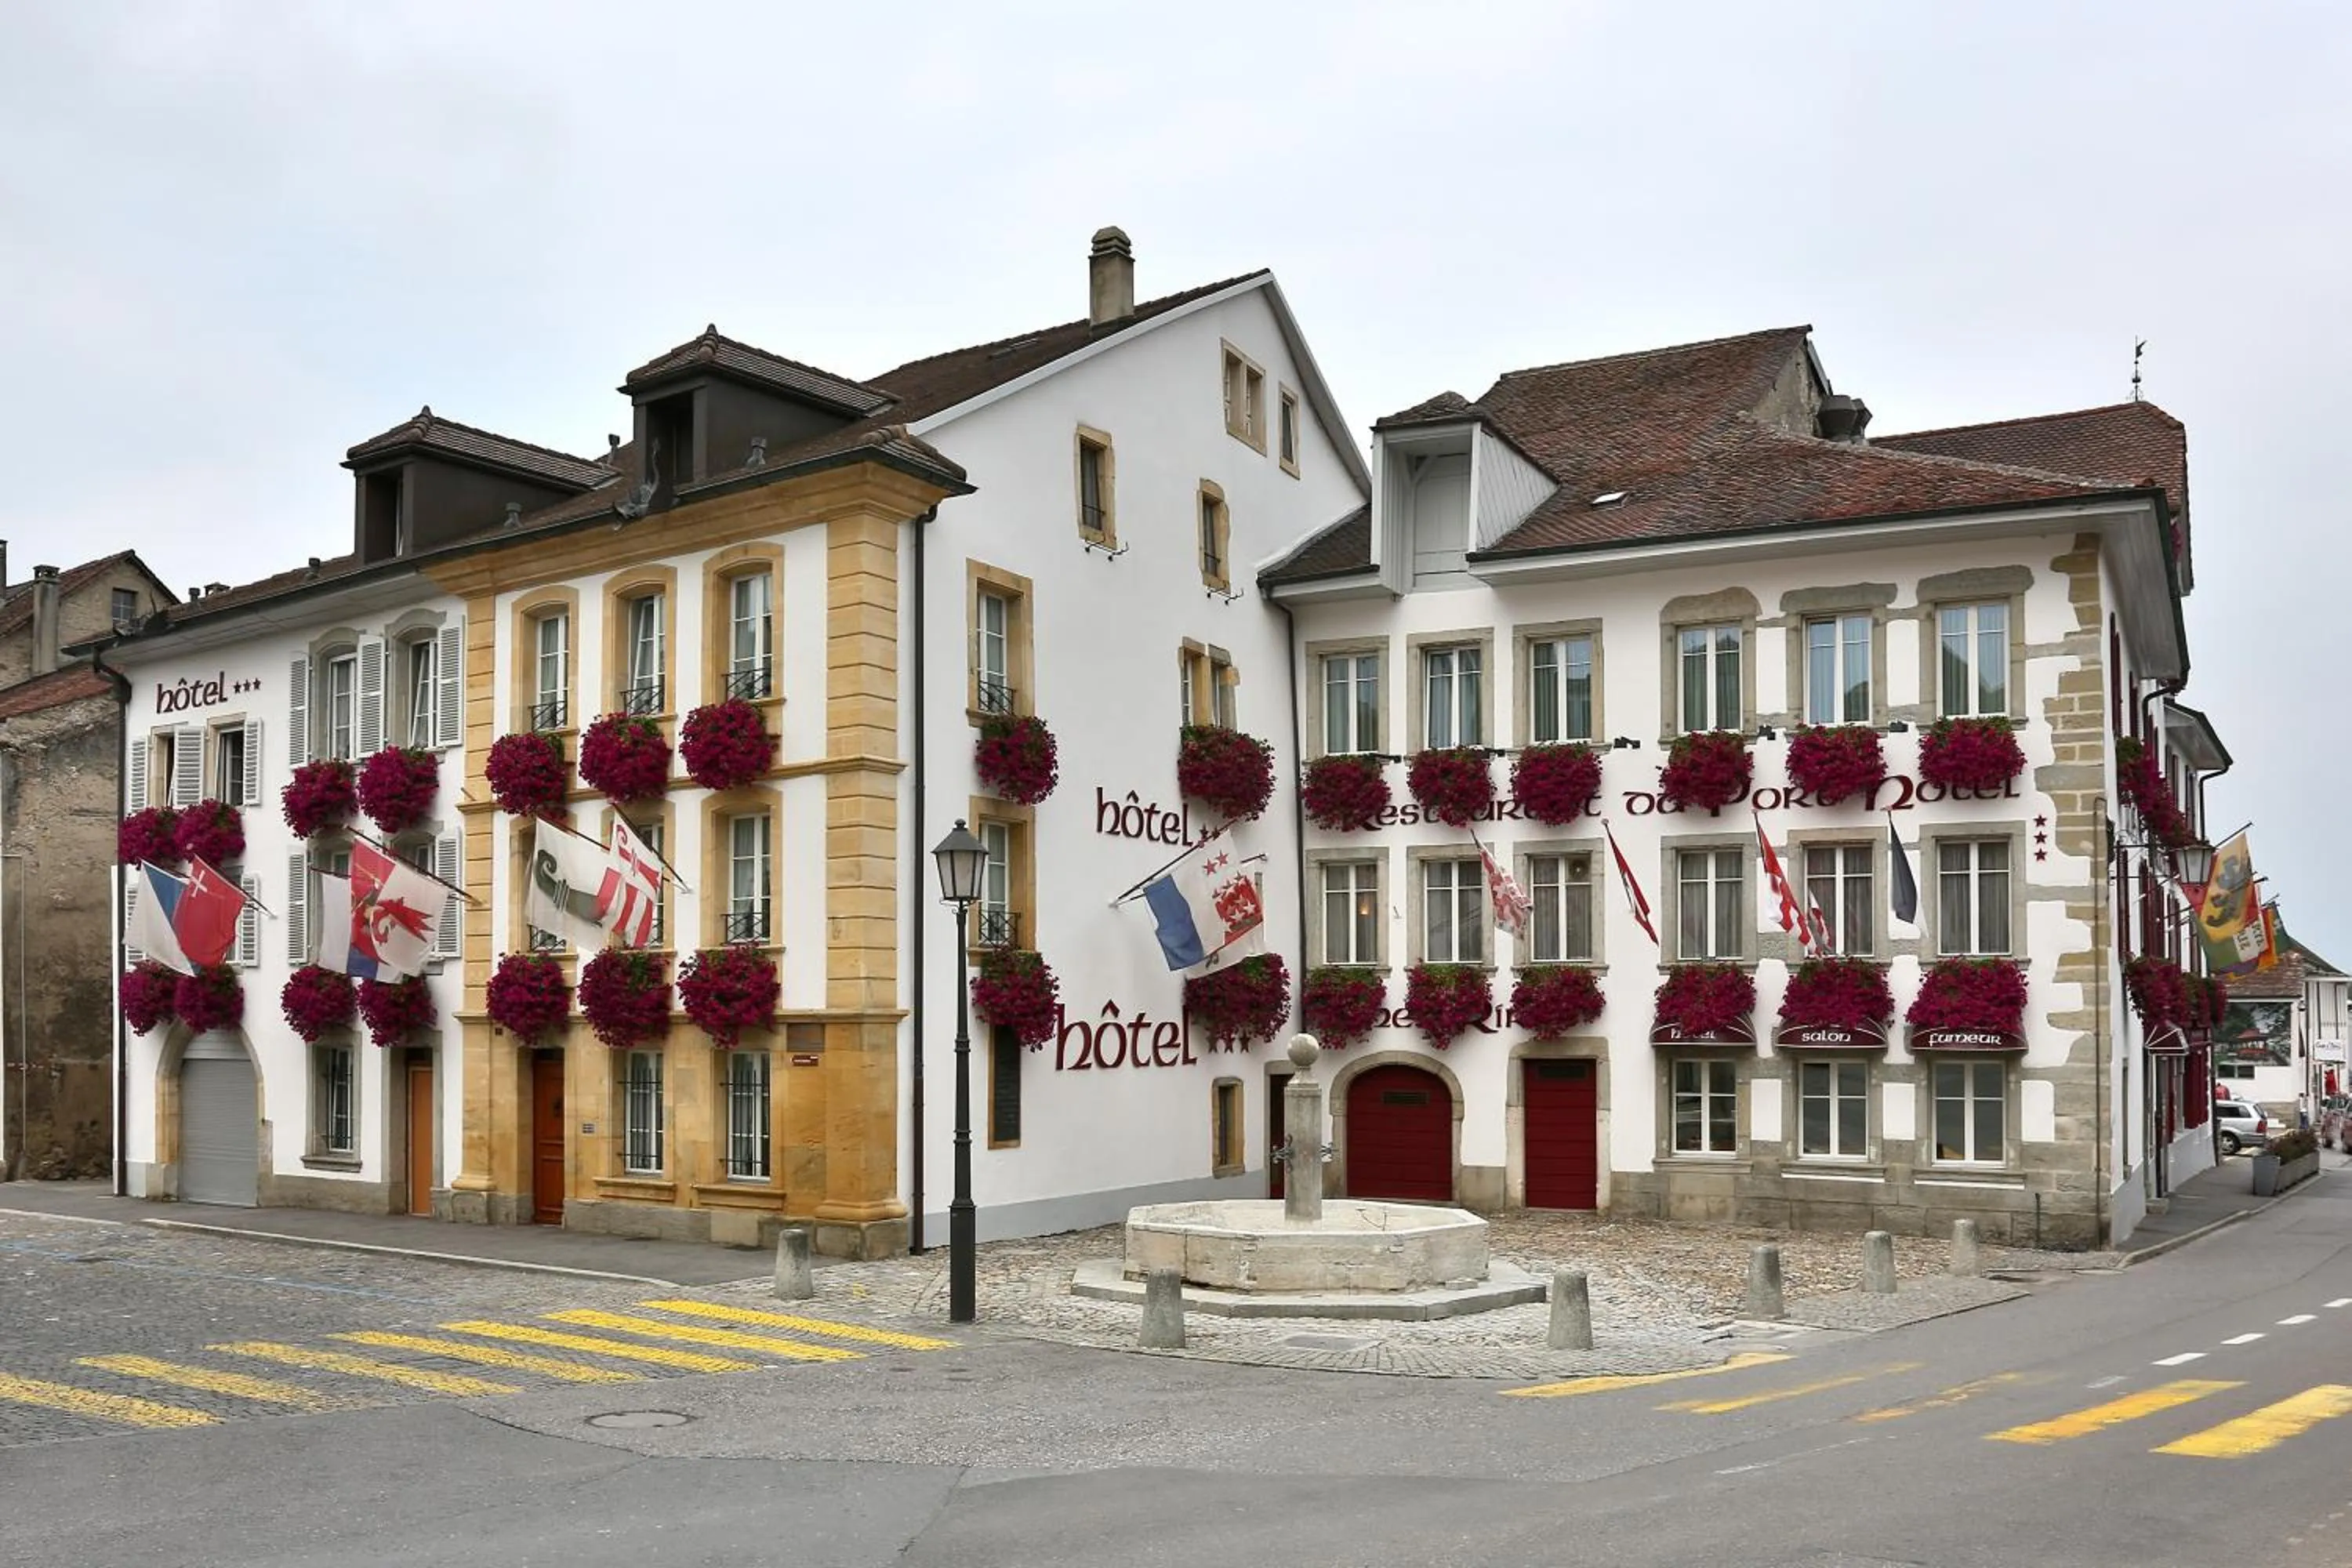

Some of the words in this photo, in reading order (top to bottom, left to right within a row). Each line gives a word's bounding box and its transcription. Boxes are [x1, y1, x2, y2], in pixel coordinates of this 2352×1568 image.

[157, 671, 227, 714] hôtel
[1096, 786, 1192, 848] hôtel
[1055, 999, 1198, 1071] hôtel
[1802, 1029, 1852, 1043] salon
[1929, 1032, 2002, 1047] fumeur
